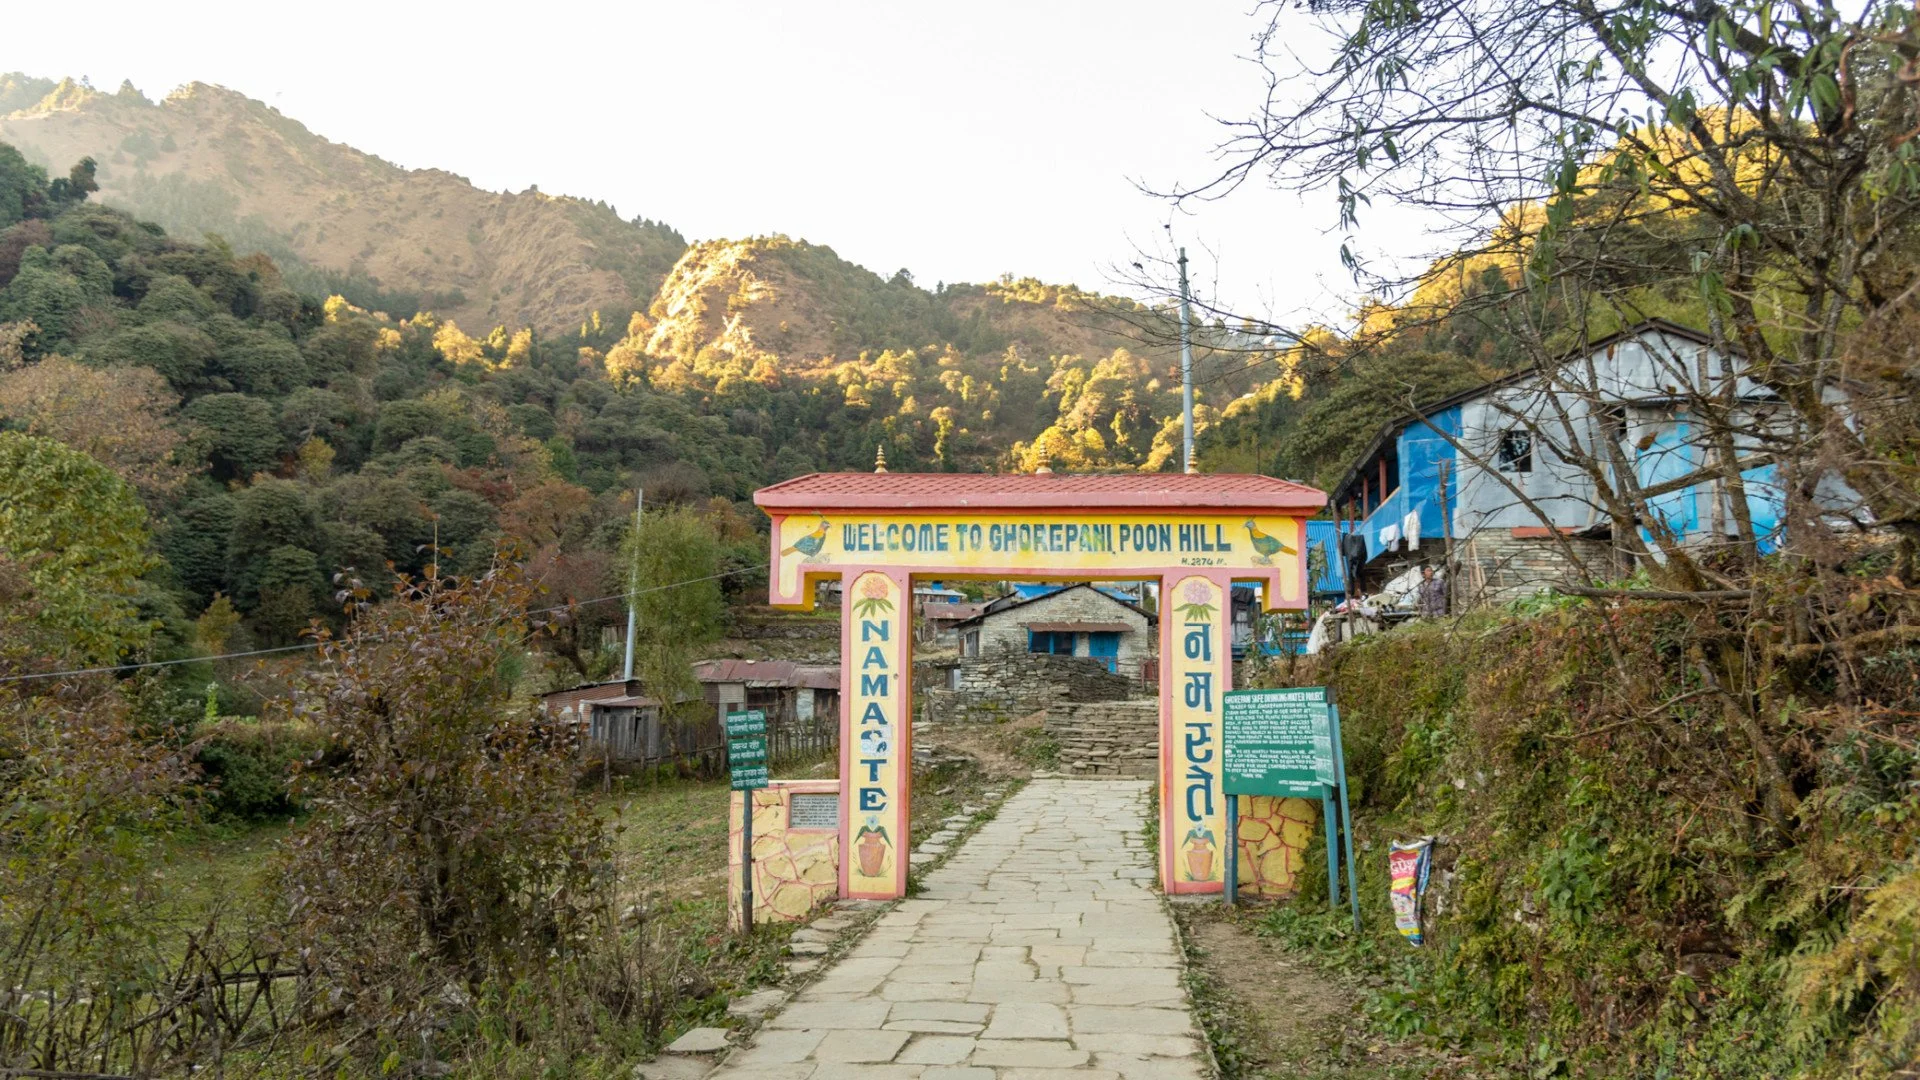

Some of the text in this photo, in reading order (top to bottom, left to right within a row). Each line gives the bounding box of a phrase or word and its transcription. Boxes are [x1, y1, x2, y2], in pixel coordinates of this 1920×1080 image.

[956, 524, 982, 551] TO
[1119, 524, 1171, 552] POON
[1178, 524, 1232, 552] HILL
[1252, 694, 1264, 703] SAFE
[1288, 693, 1304, 702] WATER
[859, 620, 891, 812] NAMASTE
